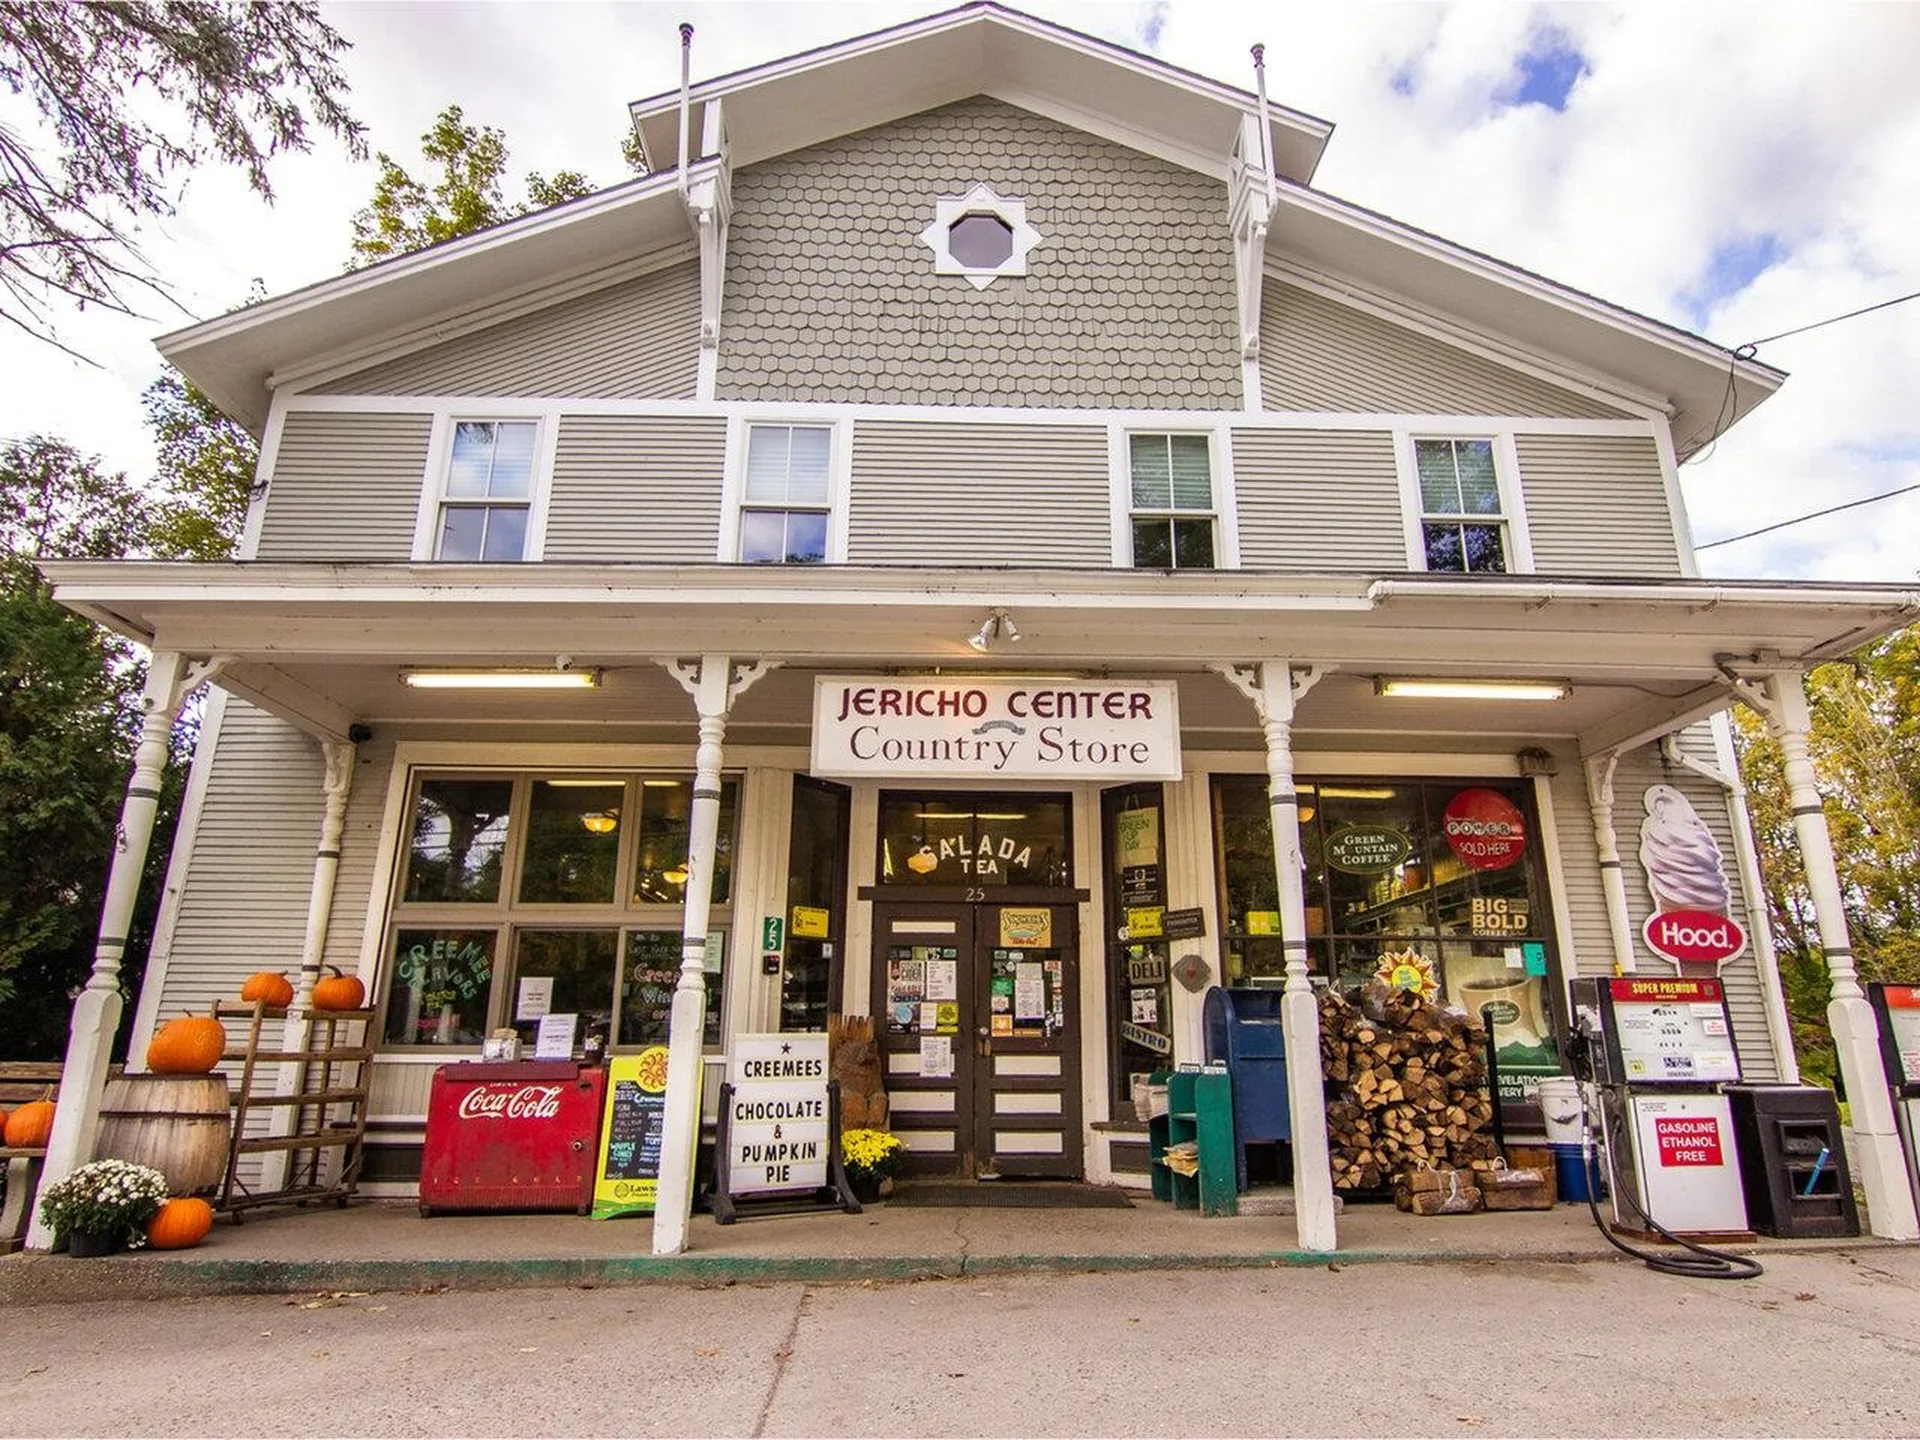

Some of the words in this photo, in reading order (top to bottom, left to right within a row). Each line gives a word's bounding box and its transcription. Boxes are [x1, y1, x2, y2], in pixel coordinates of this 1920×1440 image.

[838, 688, 989, 722] JERICHO
[1007, 690, 1154, 720] CENTER
[850, 726, 1019, 770] Country
[1037, 726, 1150, 764] Store
[1344, 834, 1386, 846] GREEN
[919, 835, 1032, 869] SALADA
[1332, 843, 1399, 856] MUNTAIN
[1460, 842, 1486, 857] SOLD
[1487, 842, 1511, 856] HERE
[960, 858, 999, 875] TEA
[1341, 855, 1391, 865] COFFEE
[965, 887, 986, 902] 25
[1472, 898, 1508, 914] BIG
[1472, 914, 1528, 930] BOLD
[1132, 960, 1163, 979] DELI
[1632, 983, 1658, 993] SUPER
[1660, 983, 1698, 993] PREMIUM
[1122, 1025, 1166, 1049] BISTRO
[744, 1060, 822, 1077] CREEMEES
[459, 1086, 564, 1119] Coca-Cola
[736, 1101, 822, 1120] CHOCOLATE
[774, 1125, 782, 1139] &
[1658, 1122, 1716, 1135] GASOLINE
[1662, 1136, 1716, 1148] ETHANOL
[742, 1143, 816, 1163] PUMPKIN
[1675, 1150, 1707, 1161] FREE
[766, 1165, 790, 1183] PIE
